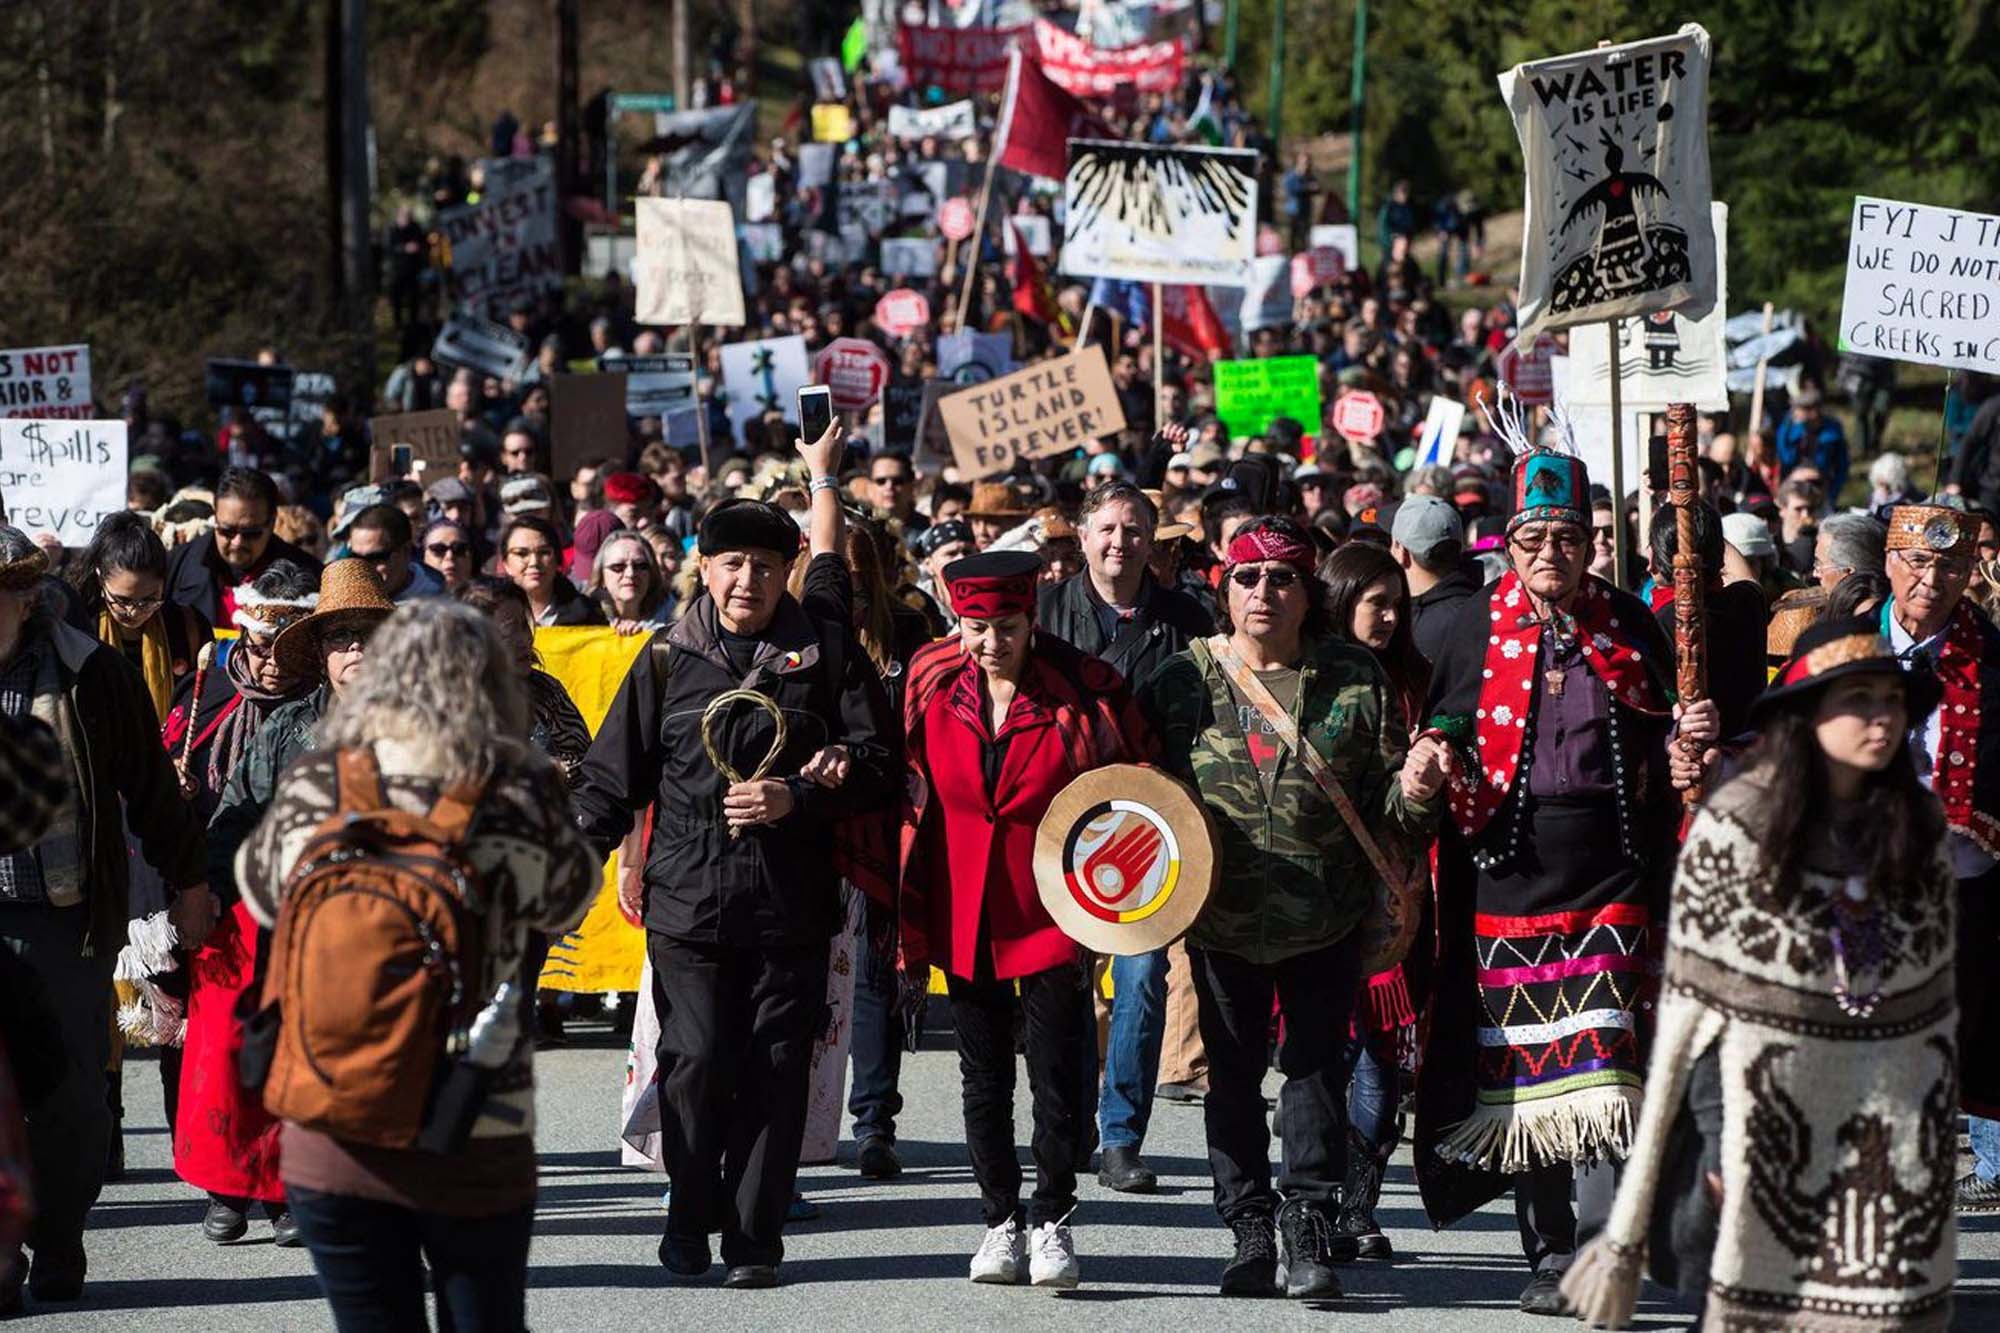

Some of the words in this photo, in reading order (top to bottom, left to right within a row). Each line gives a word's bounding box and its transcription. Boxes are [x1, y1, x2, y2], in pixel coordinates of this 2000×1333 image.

[1531, 51, 1687, 108] WATER
[1572, 102, 1594, 125] IS
[1603, 88, 1655, 118] LIFE
[1860, 204, 1918, 238] FYI
[1856, 244, 1894, 270] WE
[1910, 251, 1940, 274] DO
[1950, 257, 1998, 280] NOT
[1878, 283, 1990, 320] SACRED
[1851, 321, 1942, 358] CREEKS
[1954, 341, 1978, 358] IN
[24, 351, 77, 377] NOT
[56, 376, 72, 401] &
[968, 365, 1077, 413] TURTLE
[978, 388, 1086, 437] ISLAND
[974, 407, 1104, 467] FOREVER!
[0, 471, 45, 487] are
